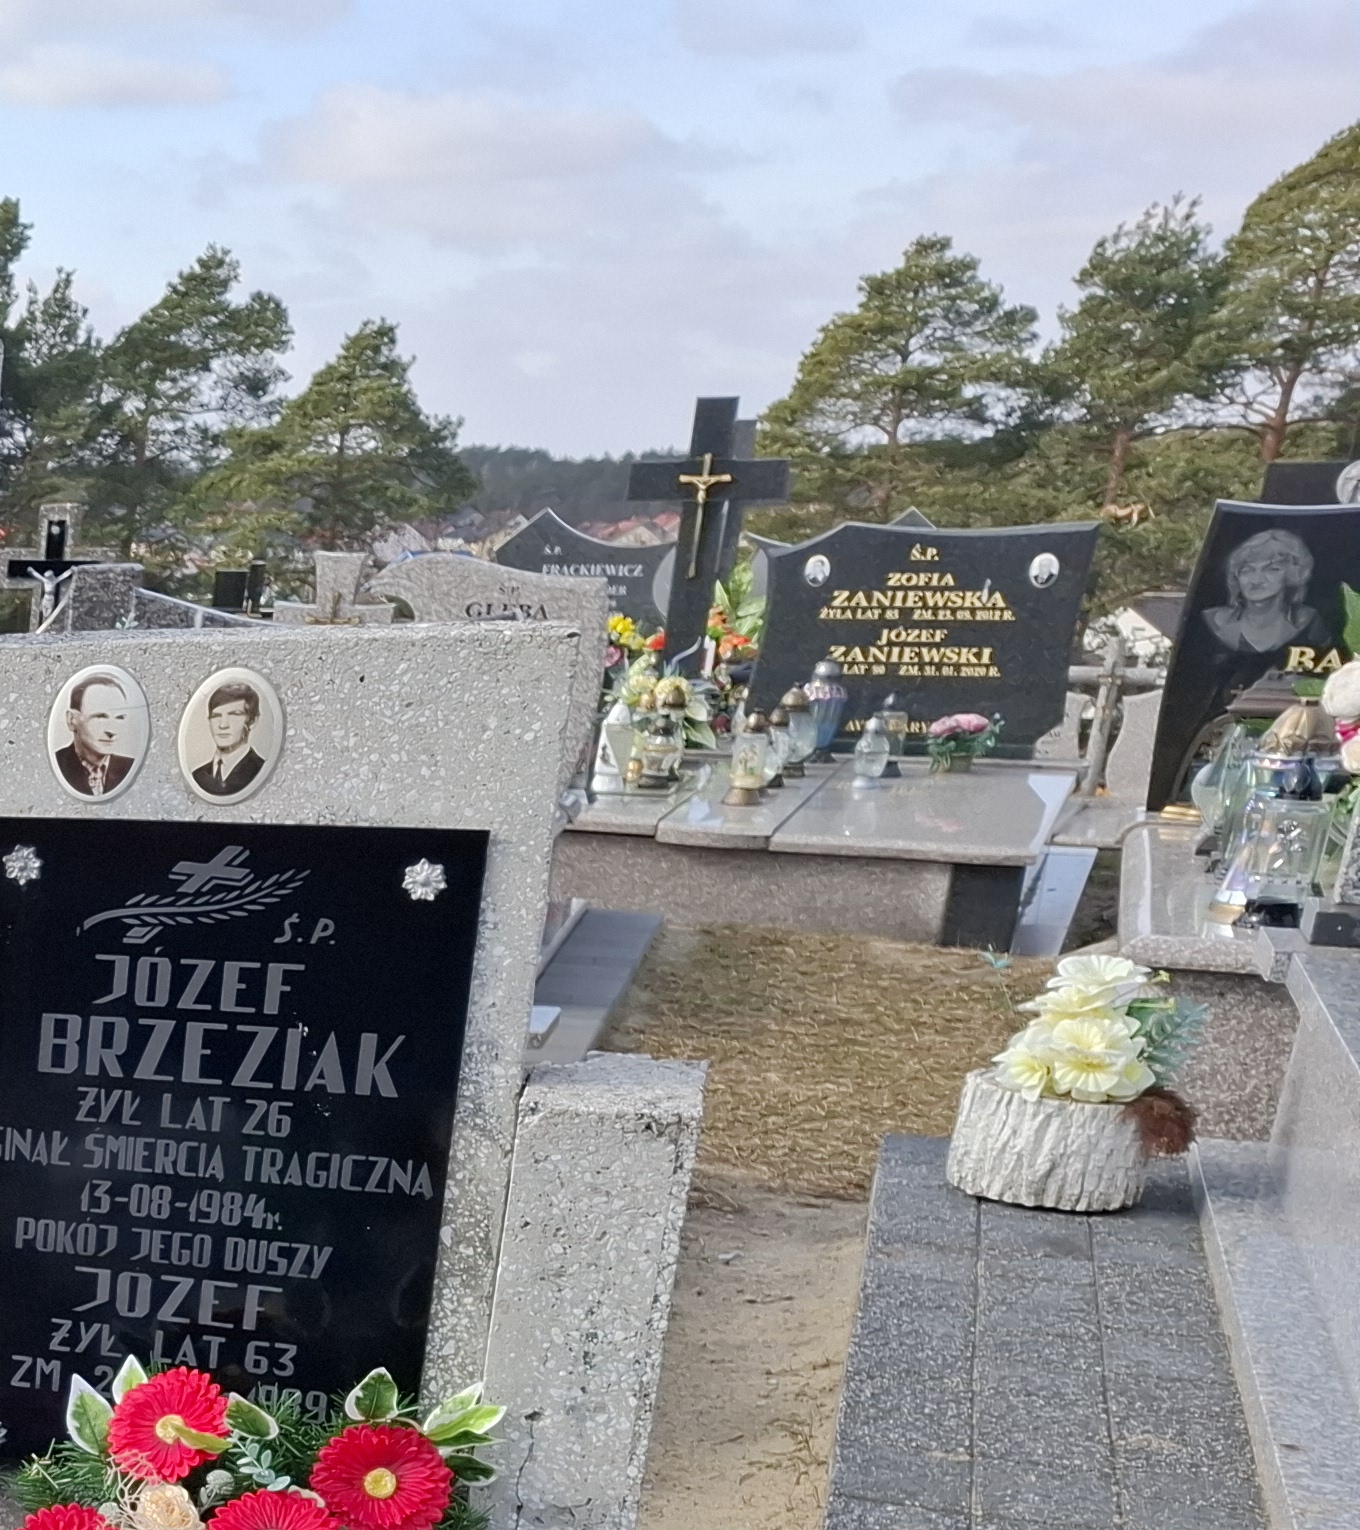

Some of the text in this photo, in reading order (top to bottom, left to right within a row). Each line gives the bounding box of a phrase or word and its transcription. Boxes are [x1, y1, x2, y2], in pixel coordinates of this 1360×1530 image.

[887, 572, 955, 587] ZOFIA
[831, 589, 1007, 608] ZANIEWSKA
[855, 608, 882, 620] LAT
[877, 625, 948, 645] JÓZEF
[829, 644, 993, 664] ZANIEWSKI
[842, 663, 868, 675] LAT
[93, 946, 306, 1015] JÓZEF
[37, 1012, 406, 1098] BRZEZIAK
[75, 1086, 294, 1138] ŻYŁ LAT 26
[82, 1127, 225, 1183] ŚMIERCIĄ
[242, 1145, 434, 1201] TRAGICZNĄ
[15, 1216, 333, 1280] POKÓJ JEGO DUSZY
[49, 1317, 298, 1377] ŻYŁ LAT 63
[10, 1355, 61, 1392] ZM
